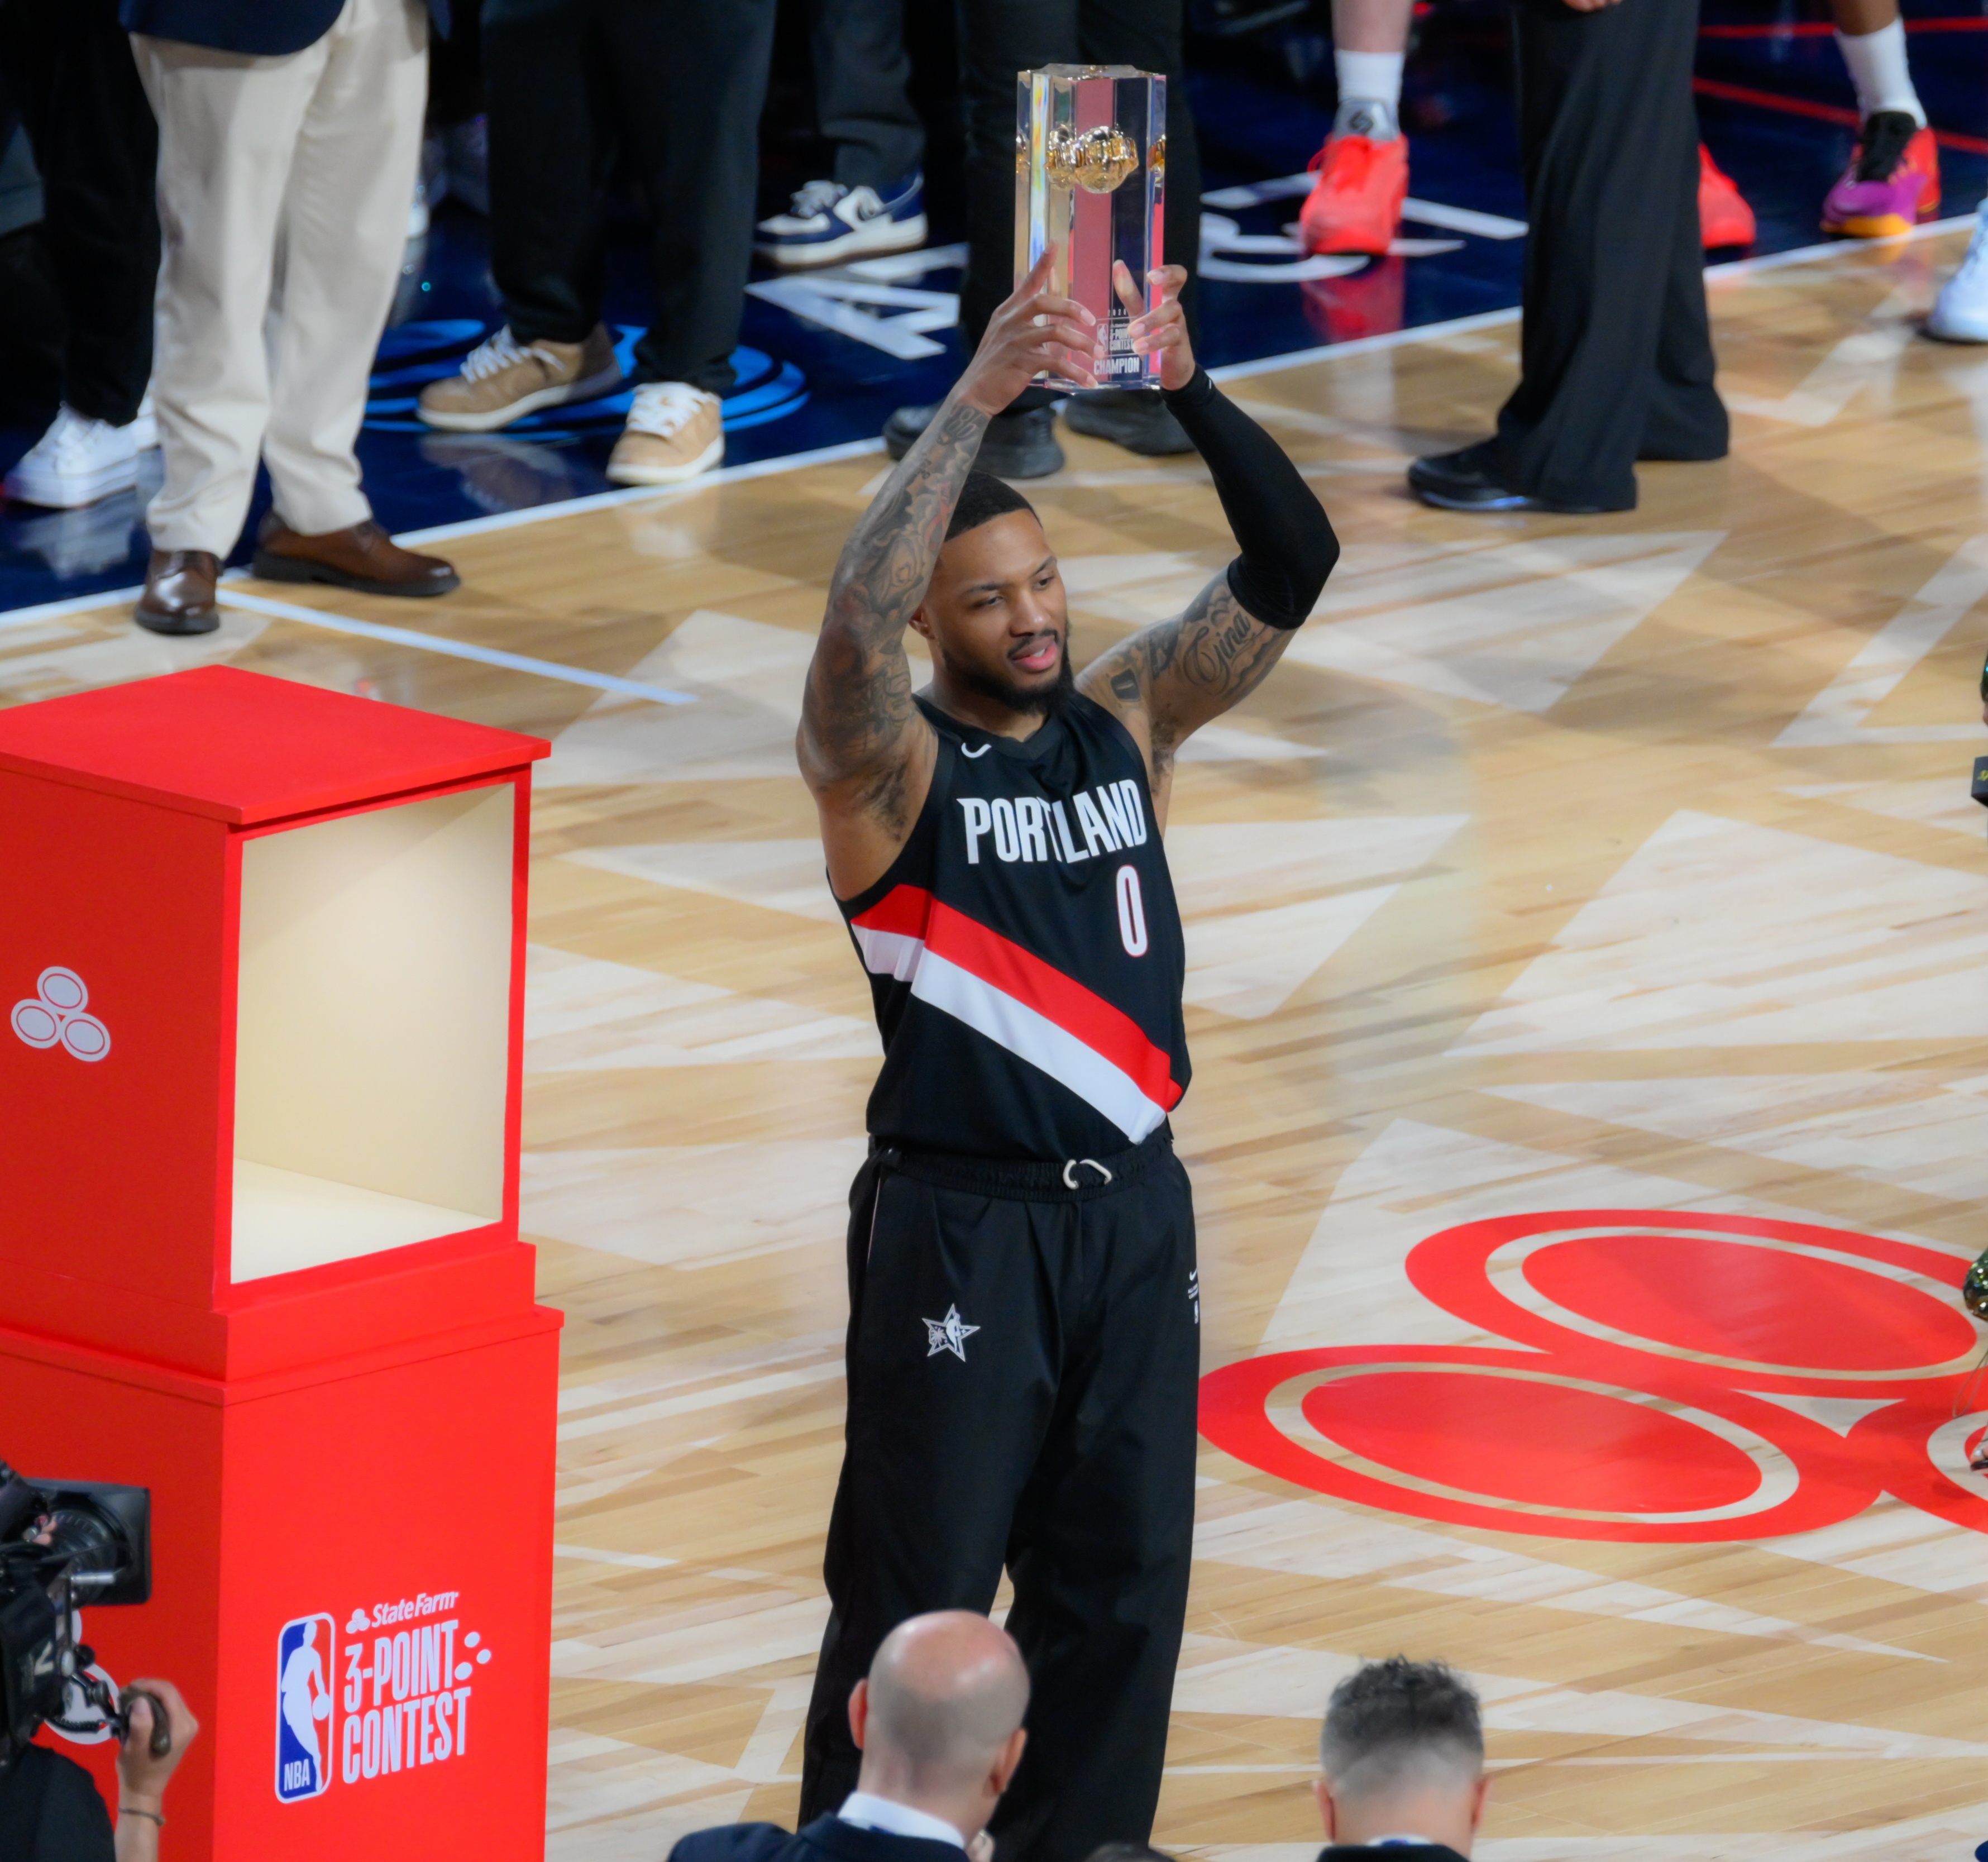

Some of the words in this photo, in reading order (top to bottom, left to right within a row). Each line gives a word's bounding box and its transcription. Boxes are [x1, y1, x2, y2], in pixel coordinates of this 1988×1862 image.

[1093, 357, 1140, 375] CHAMPION
[1110, 328, 1131, 340] 3-POIN
[955, 779, 1147, 865] PORTLAND
[1116, 864, 1148, 957] 0
[344, 1618, 458, 1713] 3-POINT
[283, 1758, 310, 1792] NBA
[342, 1686, 471, 1784] CONTEST
